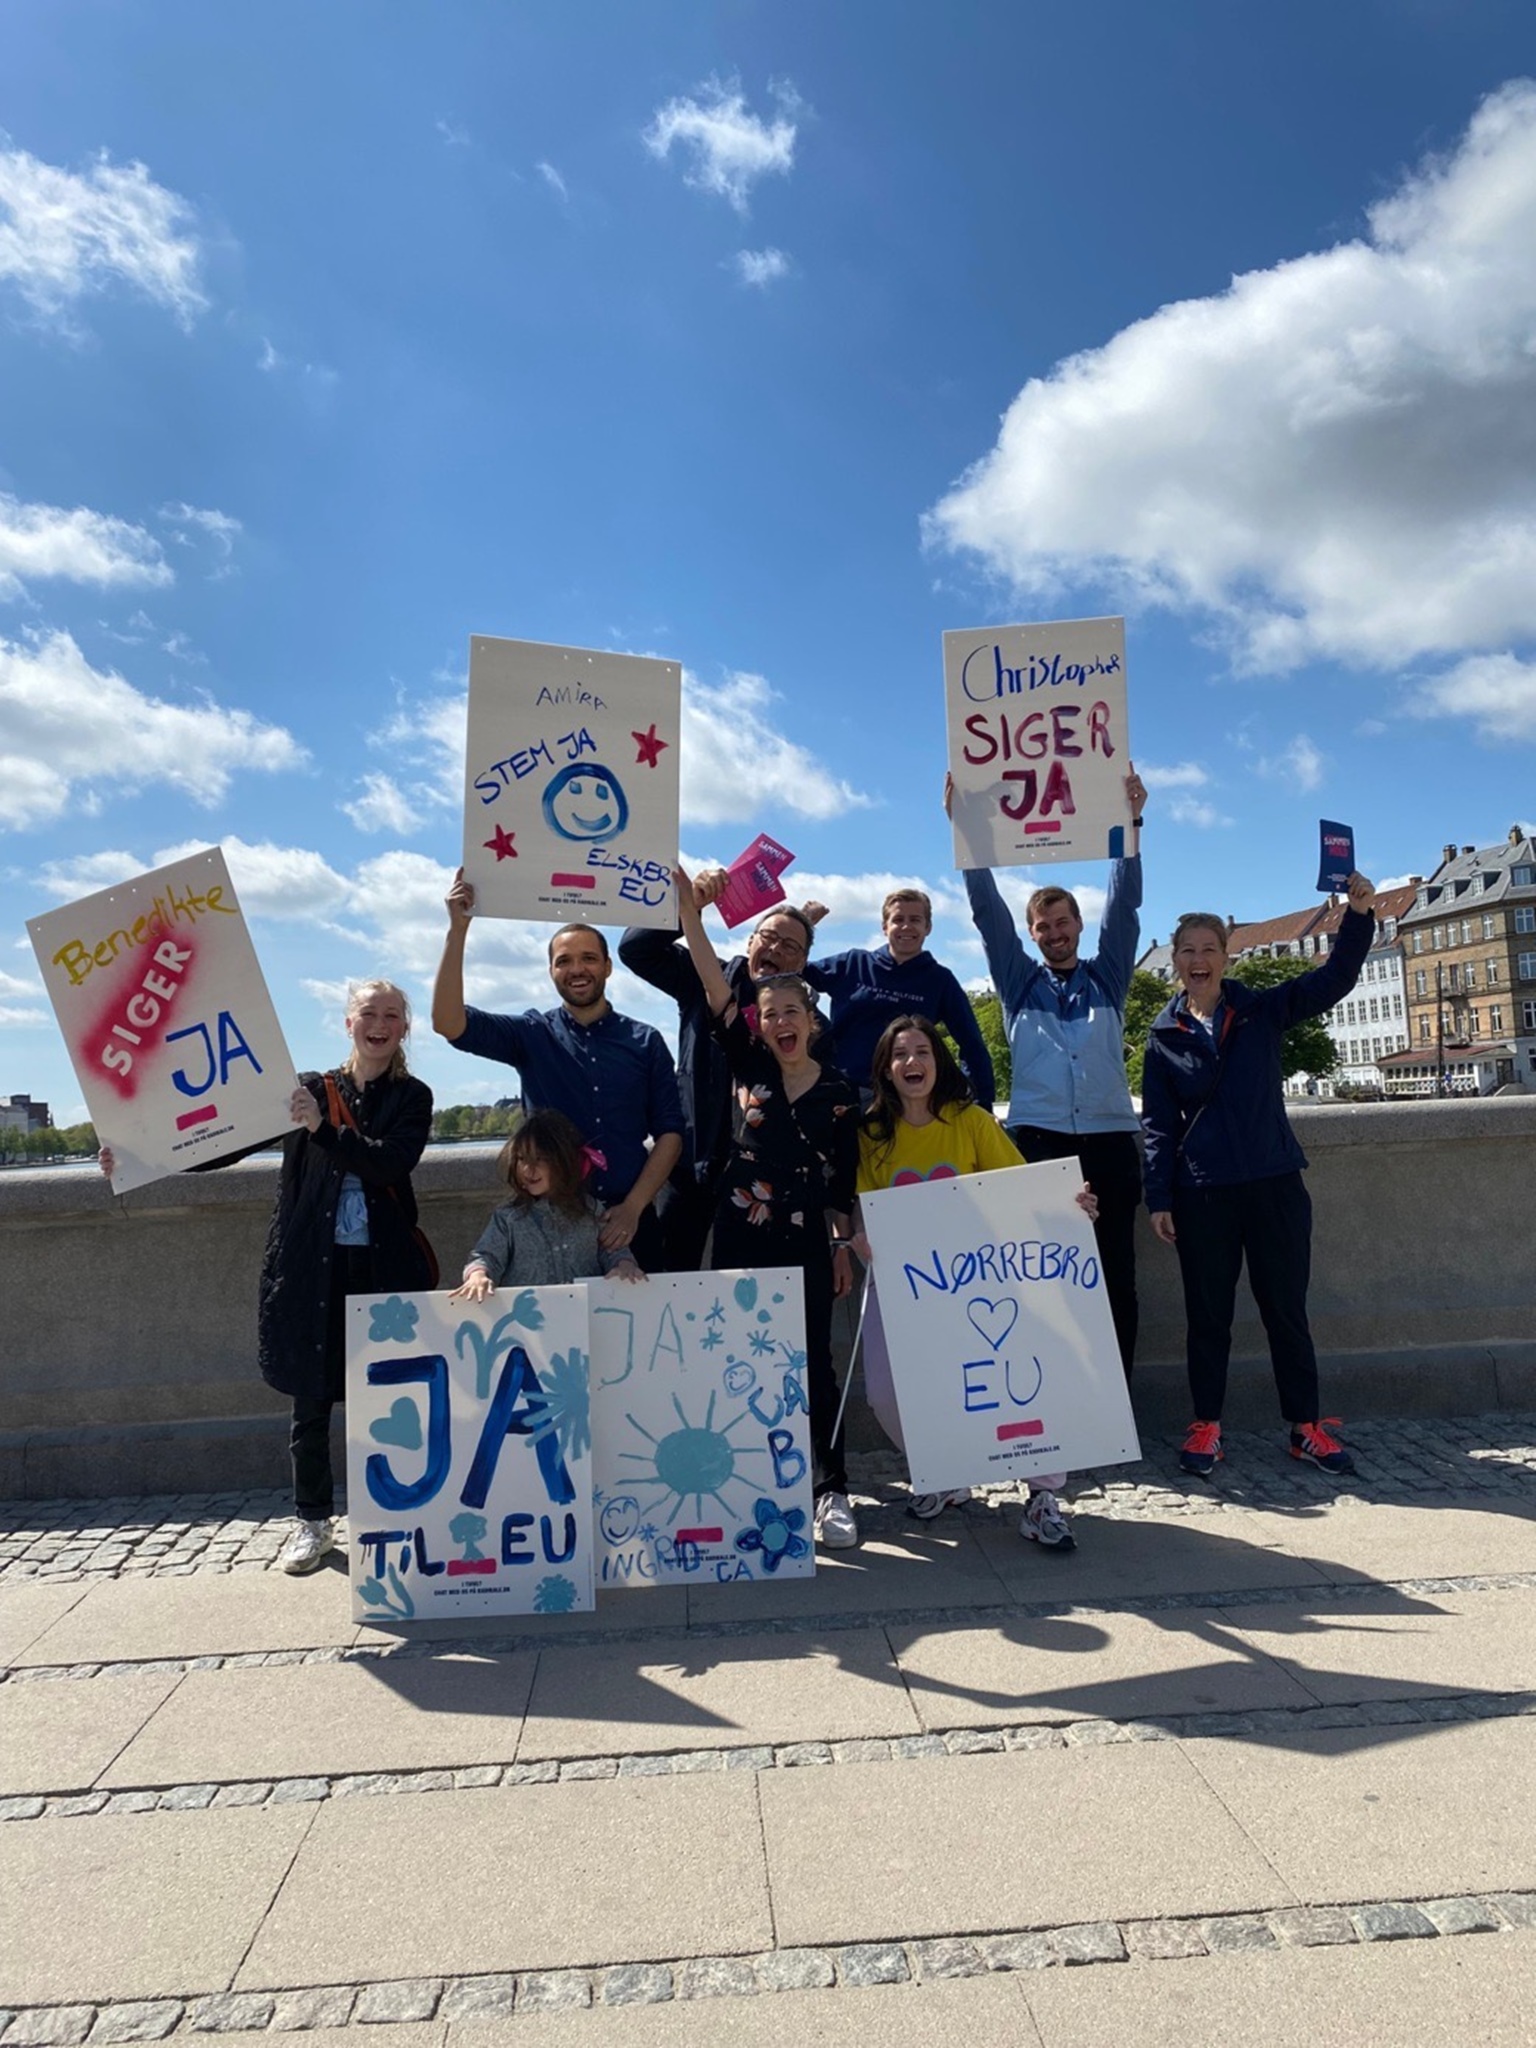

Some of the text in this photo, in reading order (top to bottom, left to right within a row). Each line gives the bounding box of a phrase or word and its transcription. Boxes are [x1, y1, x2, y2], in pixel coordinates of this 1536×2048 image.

[963, 701, 1115, 765] SIGER
[474, 727, 597, 806] STEM JA
[1000, 761, 1076, 820] JA
[586, 847, 674, 886] ELSKER
[618, 877, 665, 906] EU
[53, 884, 237, 985] Benedikte
[102, 940, 192, 1077] SIGER
[166, 1011, 263, 1097] JA
[903, 1241, 1099, 1300] NØRREBRO
[594, 1302, 685, 1390] JA
[963, 1356, 1043, 1412] EU
[366, 1346, 576, 1511] JA
[501, 1513, 577, 1566] EU
